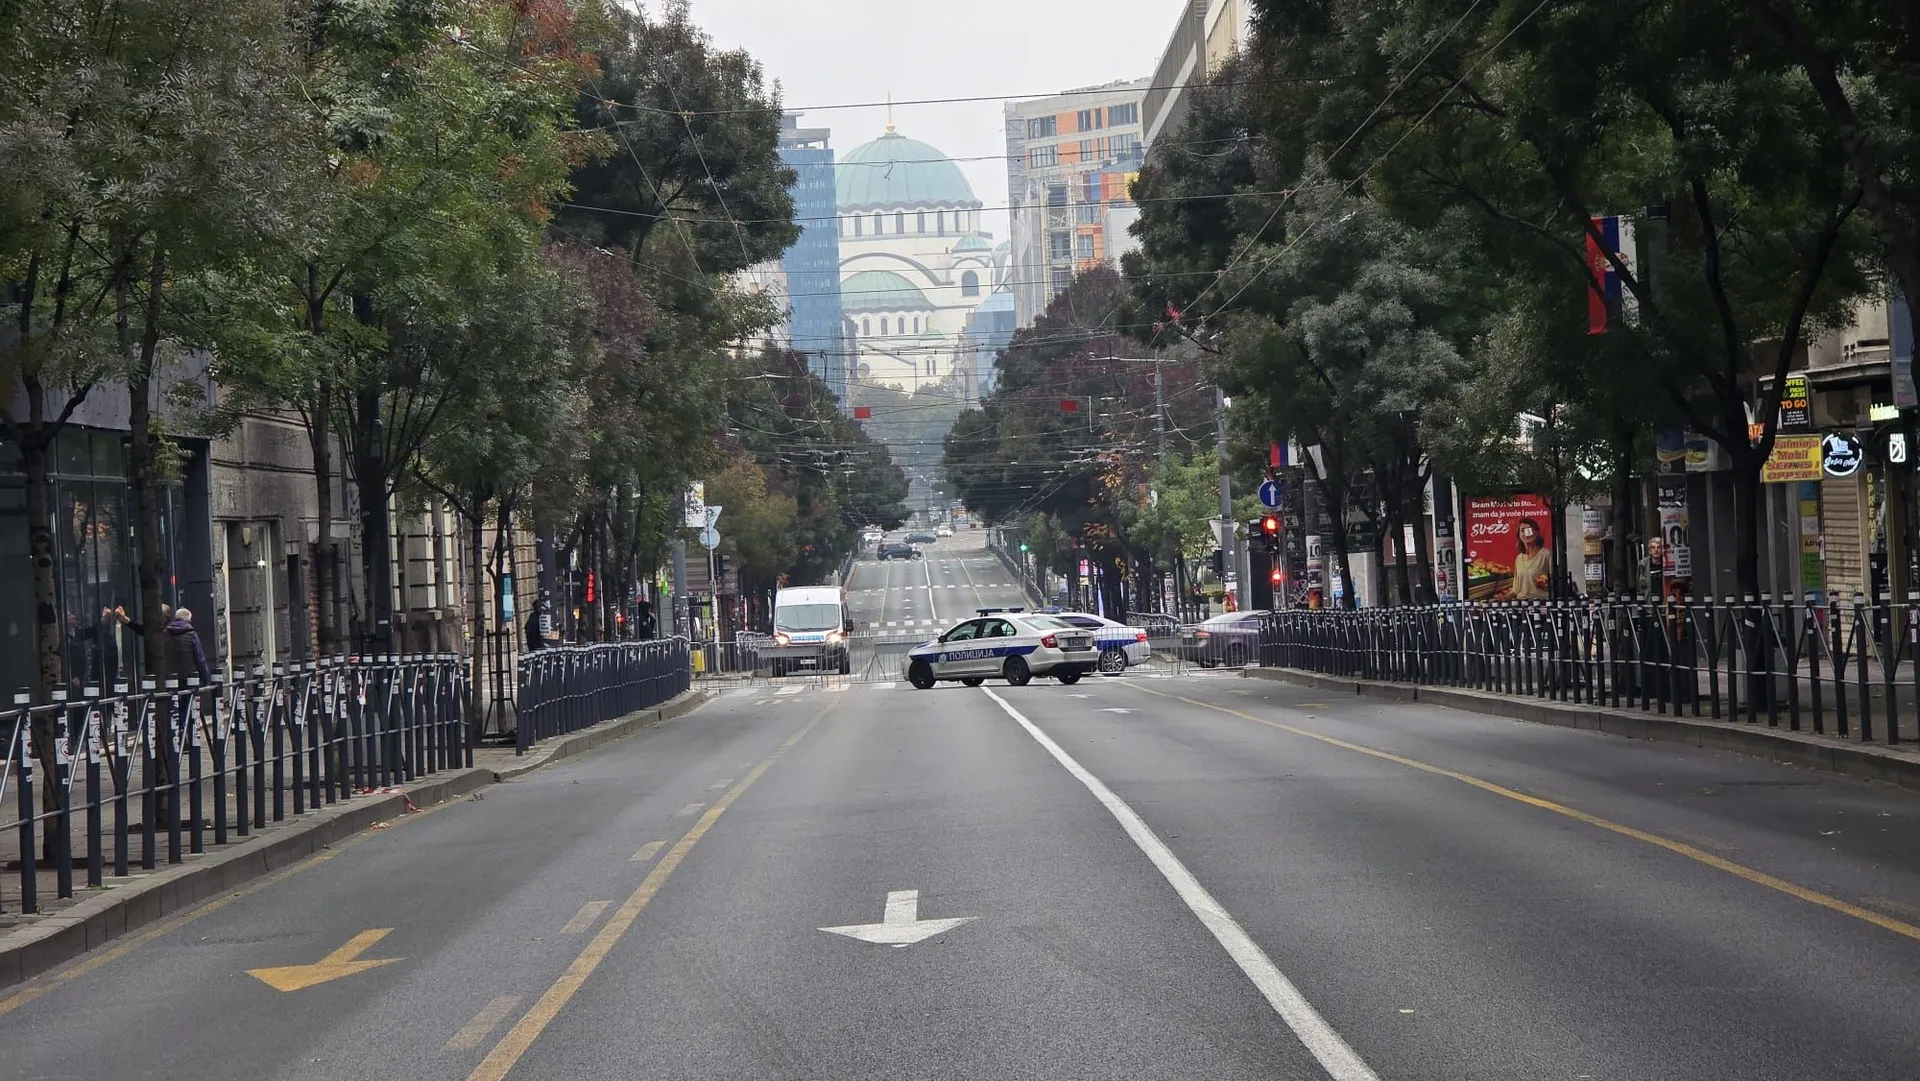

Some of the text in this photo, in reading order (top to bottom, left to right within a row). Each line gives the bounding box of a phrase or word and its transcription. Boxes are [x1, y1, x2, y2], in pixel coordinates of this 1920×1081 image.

[1785, 379, 1804, 387] OFFEE
[1780, 399, 1807, 410] TO GO
[1499, 510, 1505, 519] je
[1525, 509, 1548, 518] povrće
[948, 648, 995, 661] ПОЛИЦИЈА
